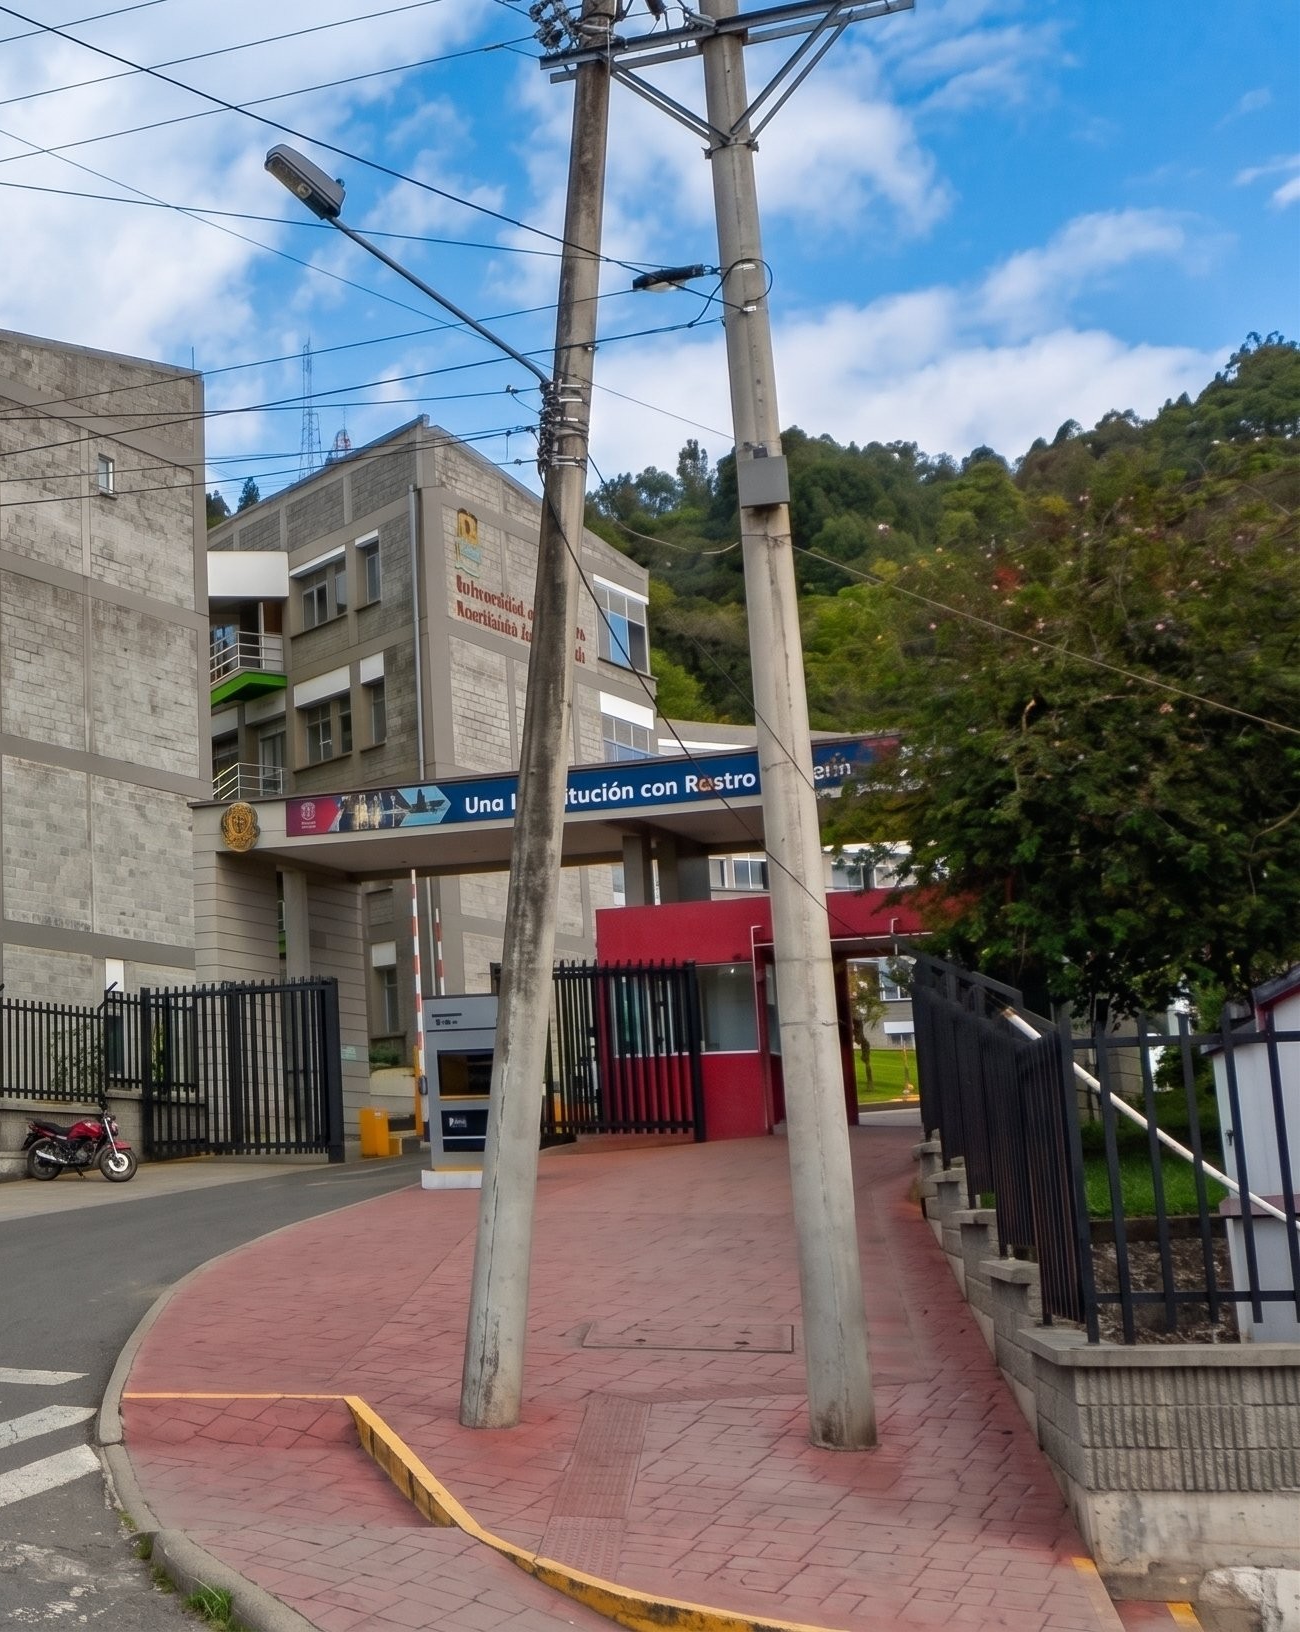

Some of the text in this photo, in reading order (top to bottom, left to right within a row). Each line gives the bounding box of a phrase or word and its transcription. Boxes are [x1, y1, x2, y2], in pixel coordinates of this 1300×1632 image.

[465, 796, 504, 815] Una
[511, 781, 634, 811] Iitución
[640, 779, 678, 798] con
